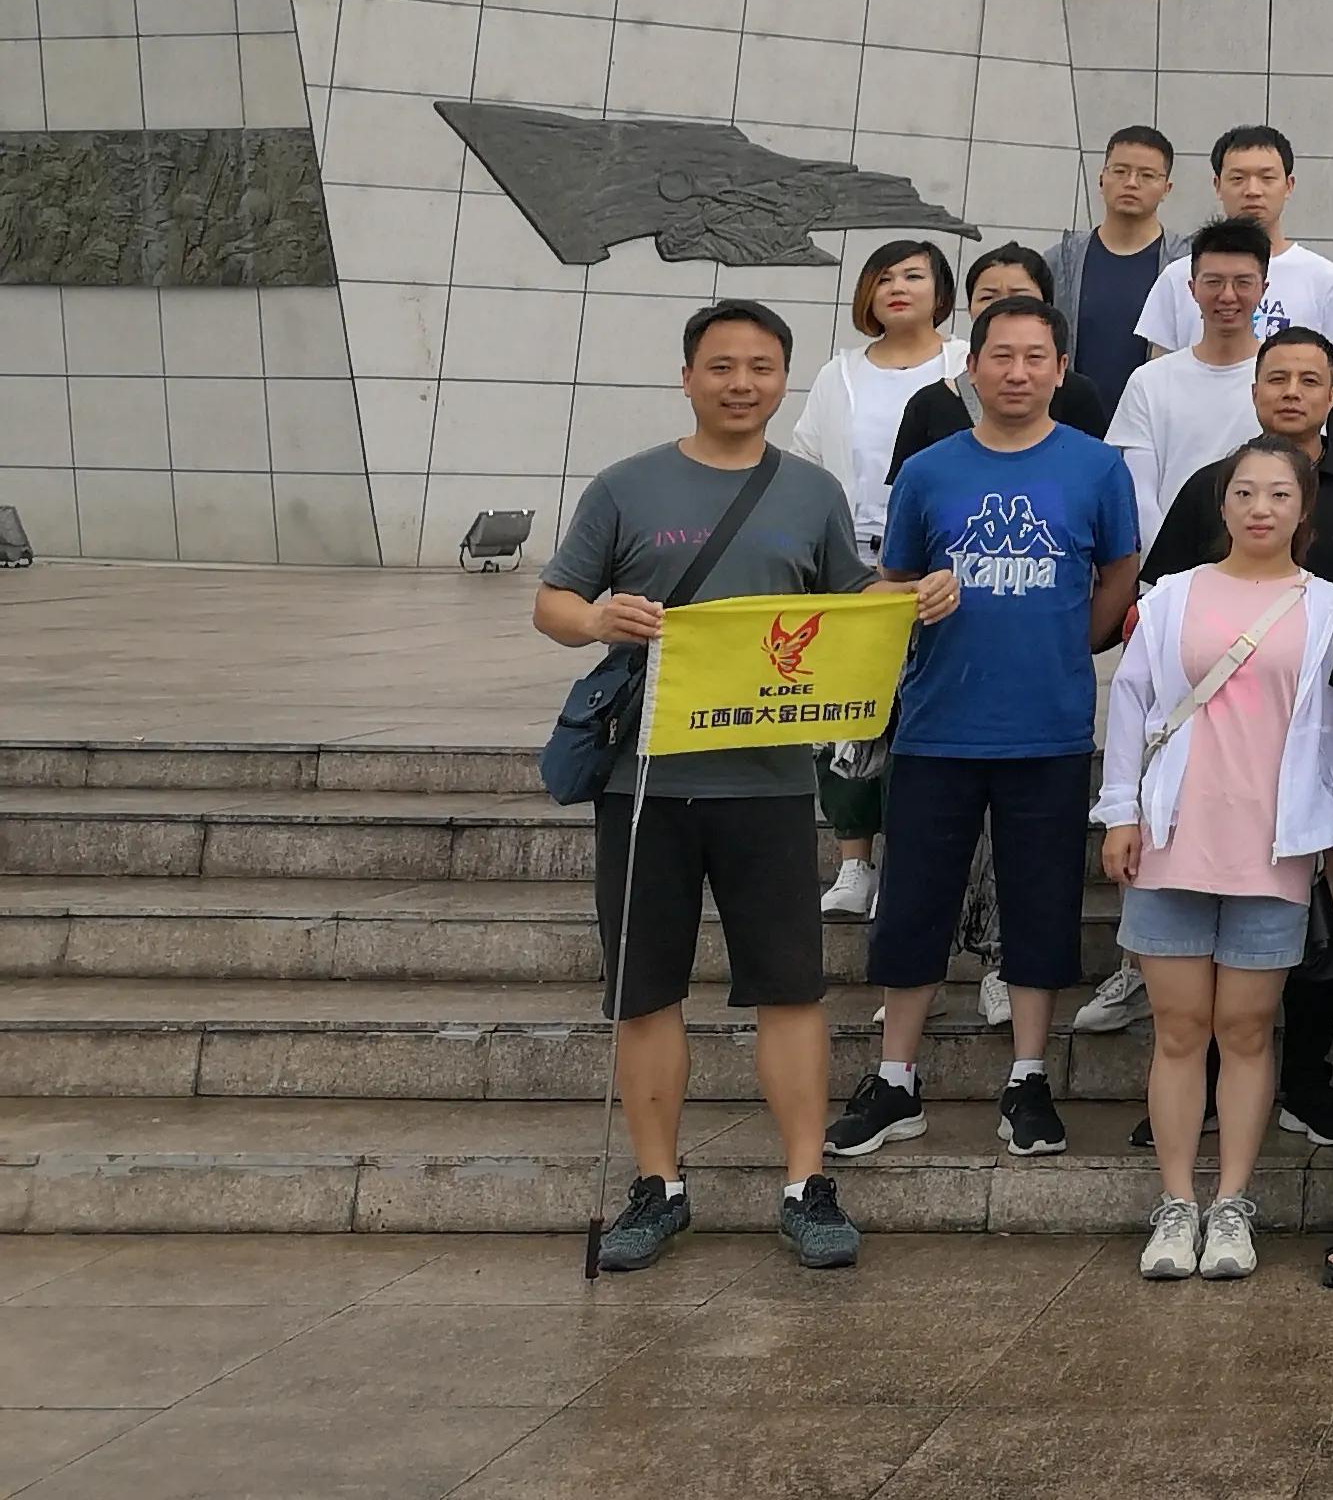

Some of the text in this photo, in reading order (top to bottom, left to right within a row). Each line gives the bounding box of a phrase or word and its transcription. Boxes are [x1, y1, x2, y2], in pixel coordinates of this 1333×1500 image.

[949, 551, 1057, 597] Kappa
[759, 683, 815, 698] K.DEE
[688, 699, 878, 731] 江西师大金日旅行社
